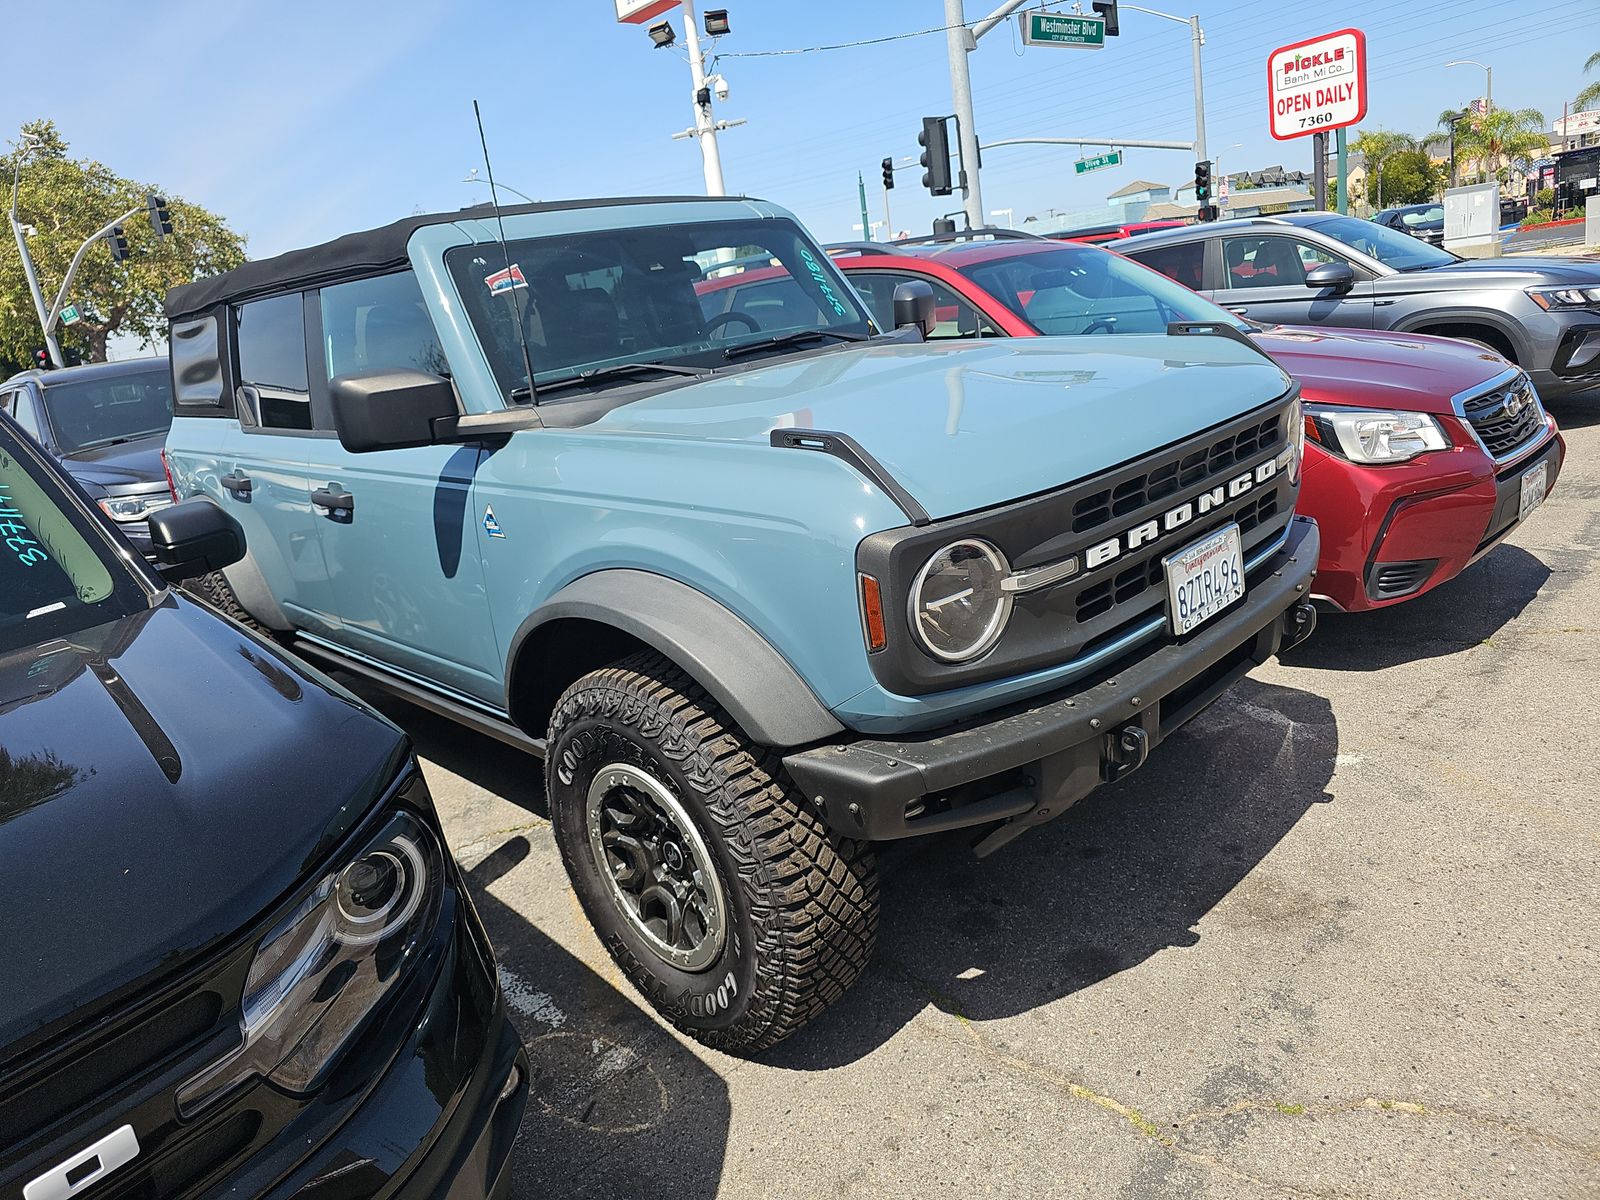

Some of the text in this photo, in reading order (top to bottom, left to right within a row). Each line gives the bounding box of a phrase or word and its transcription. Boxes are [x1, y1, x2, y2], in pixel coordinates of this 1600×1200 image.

[1040, 18, 1097, 36] Westminster Blvd
[1284, 47, 1345, 75] PICKLE
[1284, 64, 1345, 86] Banh Mi Co.
[1277, 81, 1354, 116] OPEN DAILY
[1299, 112, 1333, 129] 7360
[1085, 459, 1276, 569] BRONCO
[1177, 552, 1239, 619] 8ZIR496
[1184, 586, 1242, 630] GALPIN
